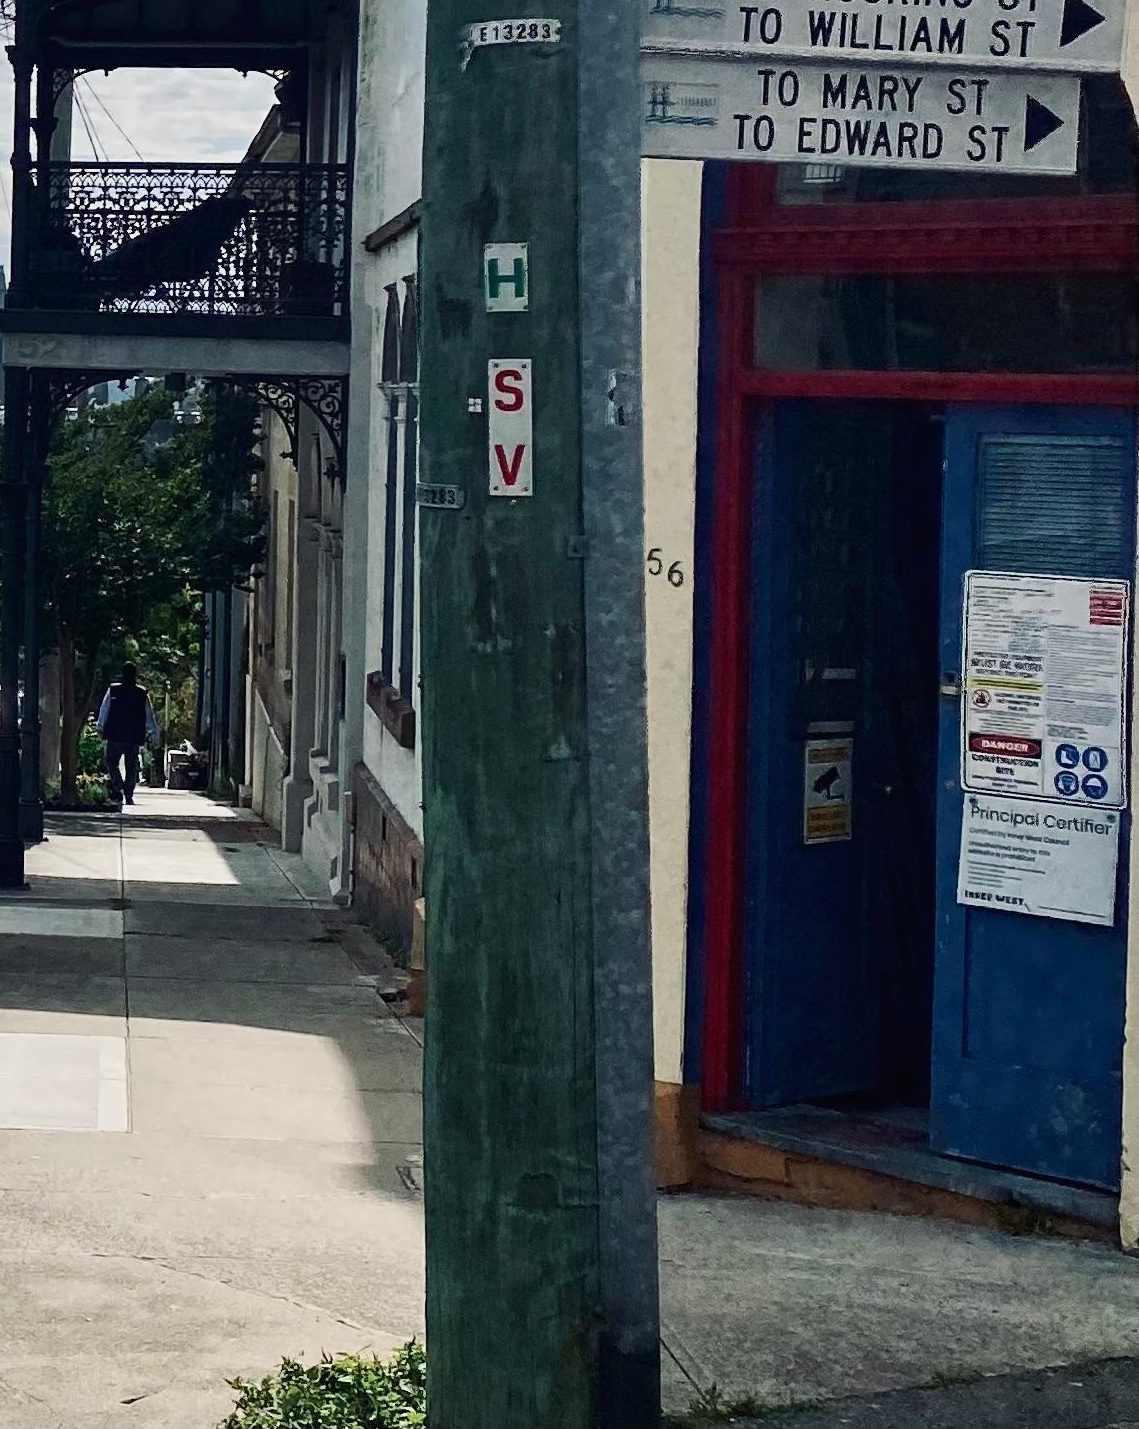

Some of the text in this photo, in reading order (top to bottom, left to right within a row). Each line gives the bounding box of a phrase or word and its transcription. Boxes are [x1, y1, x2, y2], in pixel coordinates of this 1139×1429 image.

[739, 5, 1036, 58] TO WILLIAM ST
[757, 69, 990, 116] TO MARY ST
[733, 114, 1010, 163] TO EDWARD ST
[487, 258, 525, 299] H
[494, 369, 526, 486] S V
[646, 547, 684, 587] 56
[981, 739, 1029, 753] DANGER
[970, 804, 1113, 836] Principal Certifier
[1043, 836, 1070, 846] Council
[995, 894, 1025, 906] WEST
